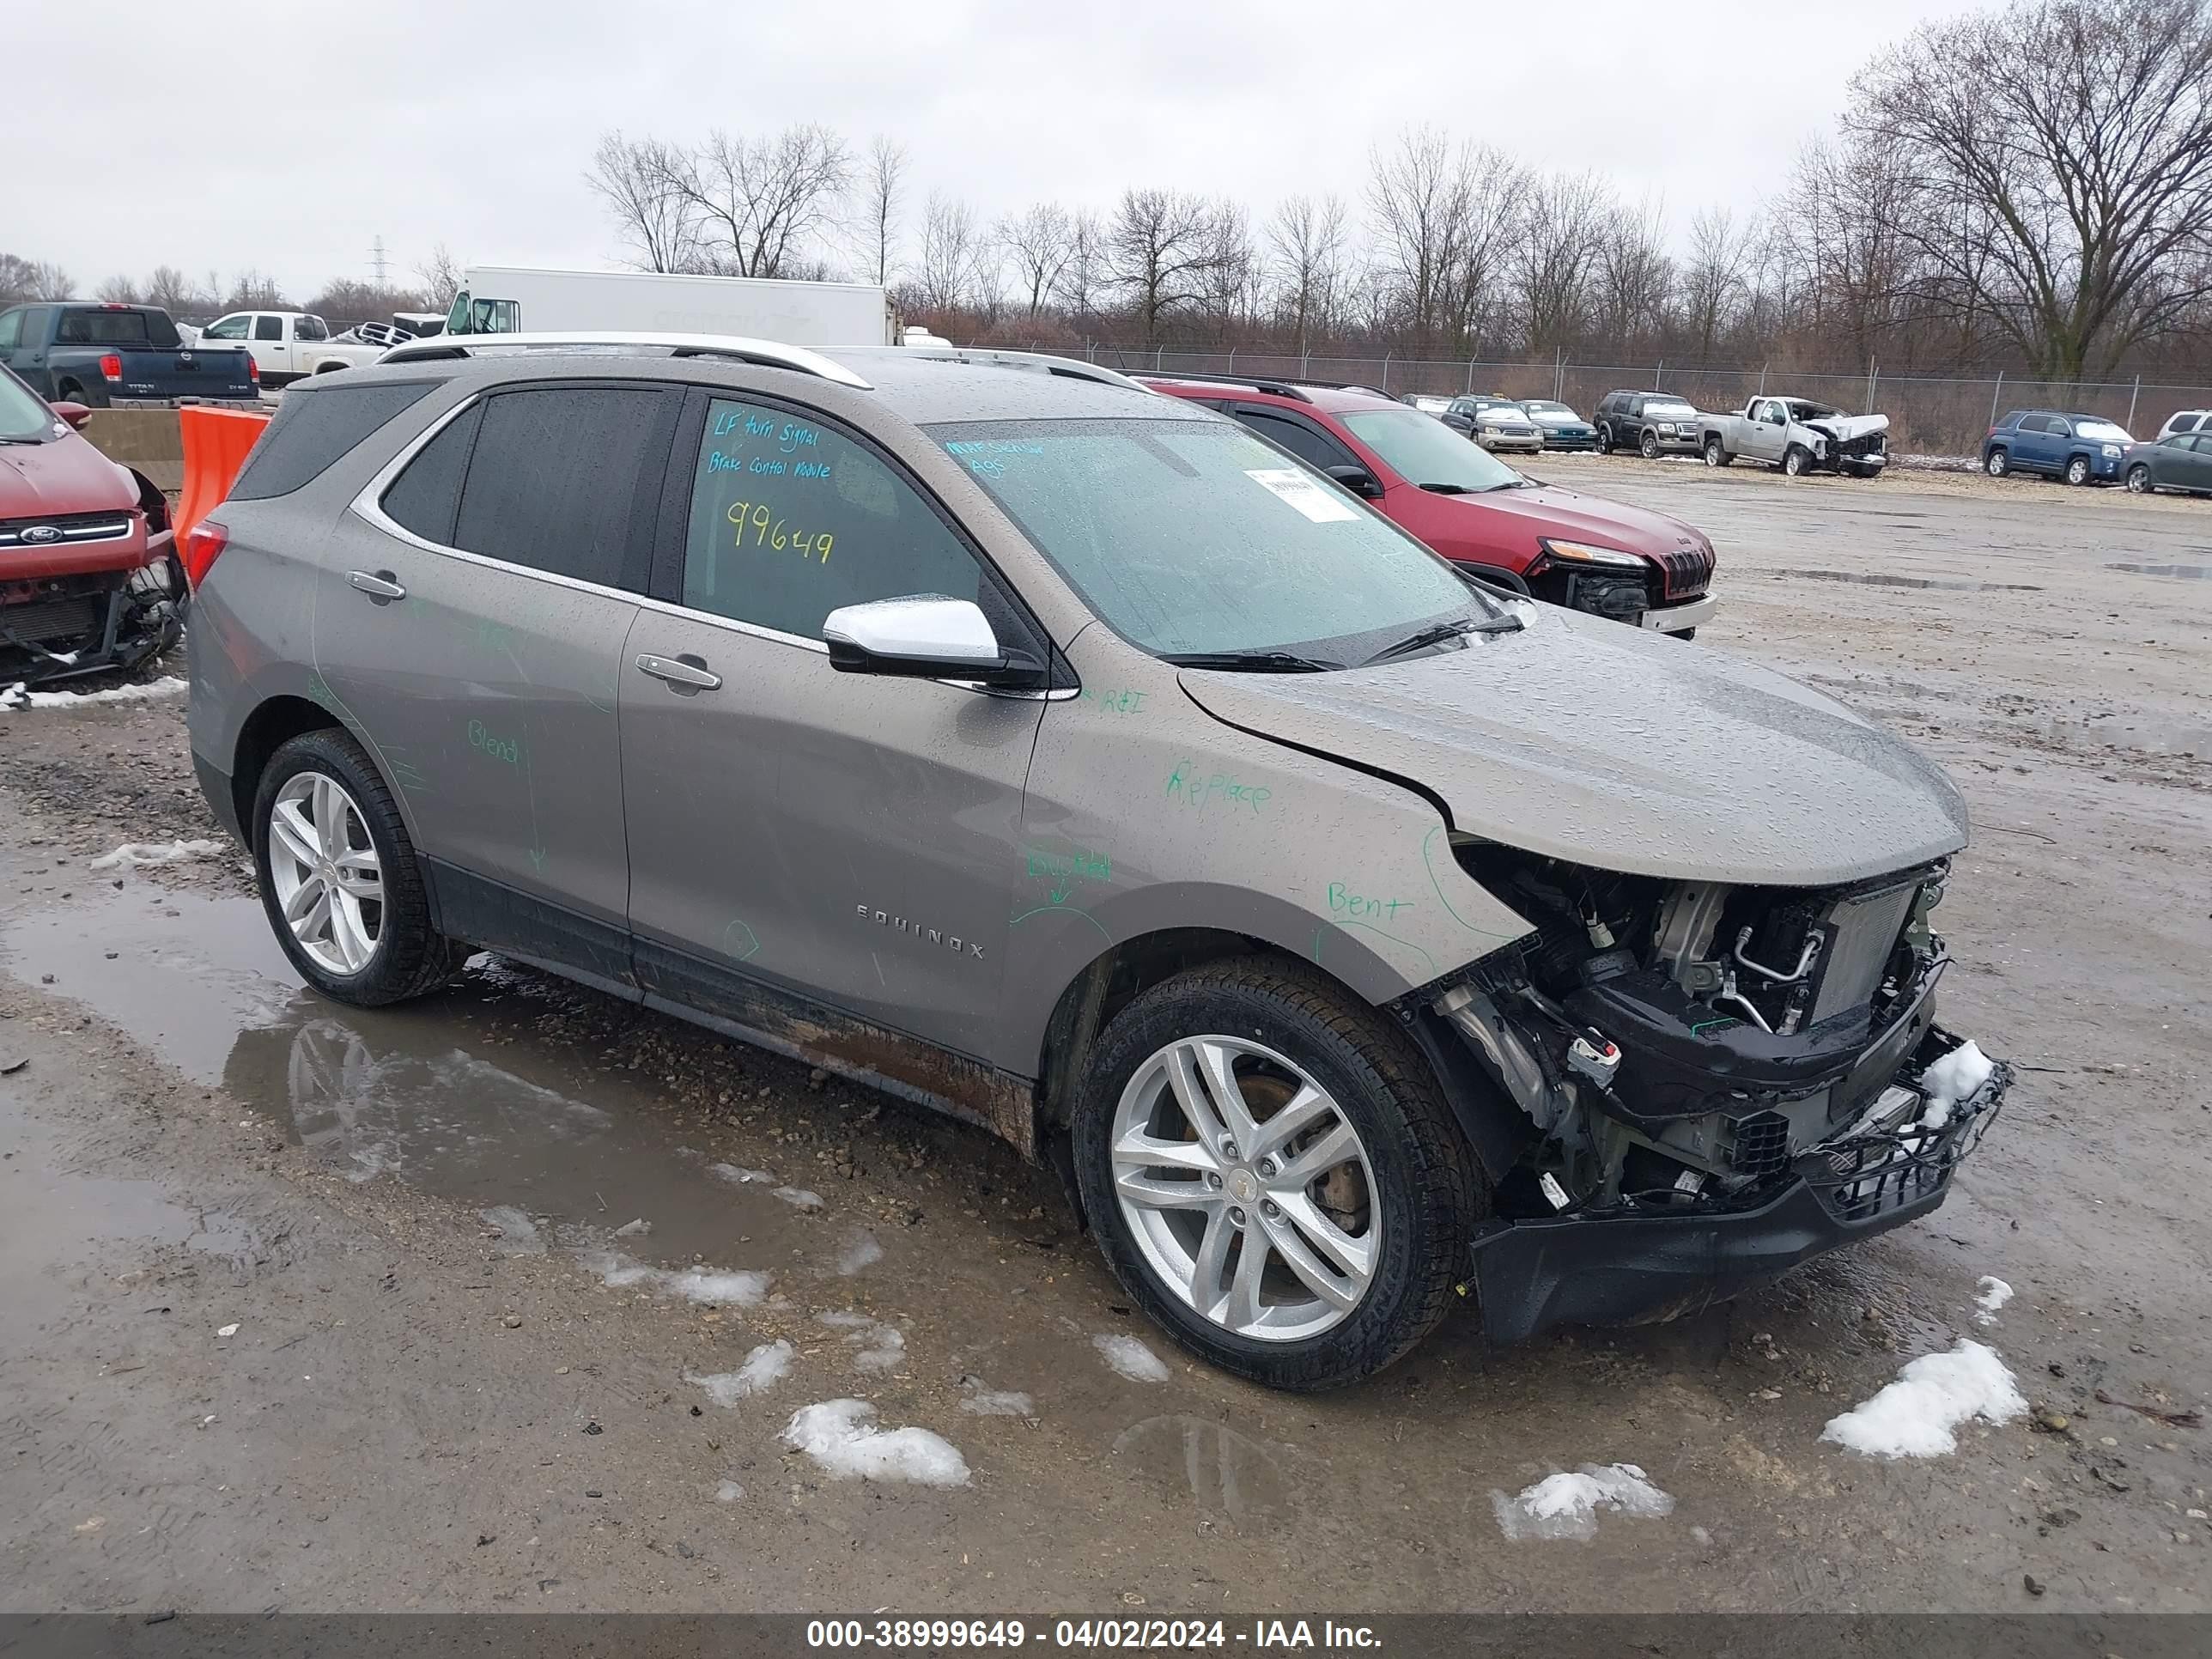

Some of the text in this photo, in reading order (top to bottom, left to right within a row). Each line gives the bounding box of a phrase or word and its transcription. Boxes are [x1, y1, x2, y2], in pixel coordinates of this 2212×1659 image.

[714, 413, 819, 453] LF turn Signal
[708, 451, 741, 473] Brake
[727, 501, 833, 563] 99649
[1328, 882, 1415, 921] Bent
[857, 904, 984, 960] EQUINOX
